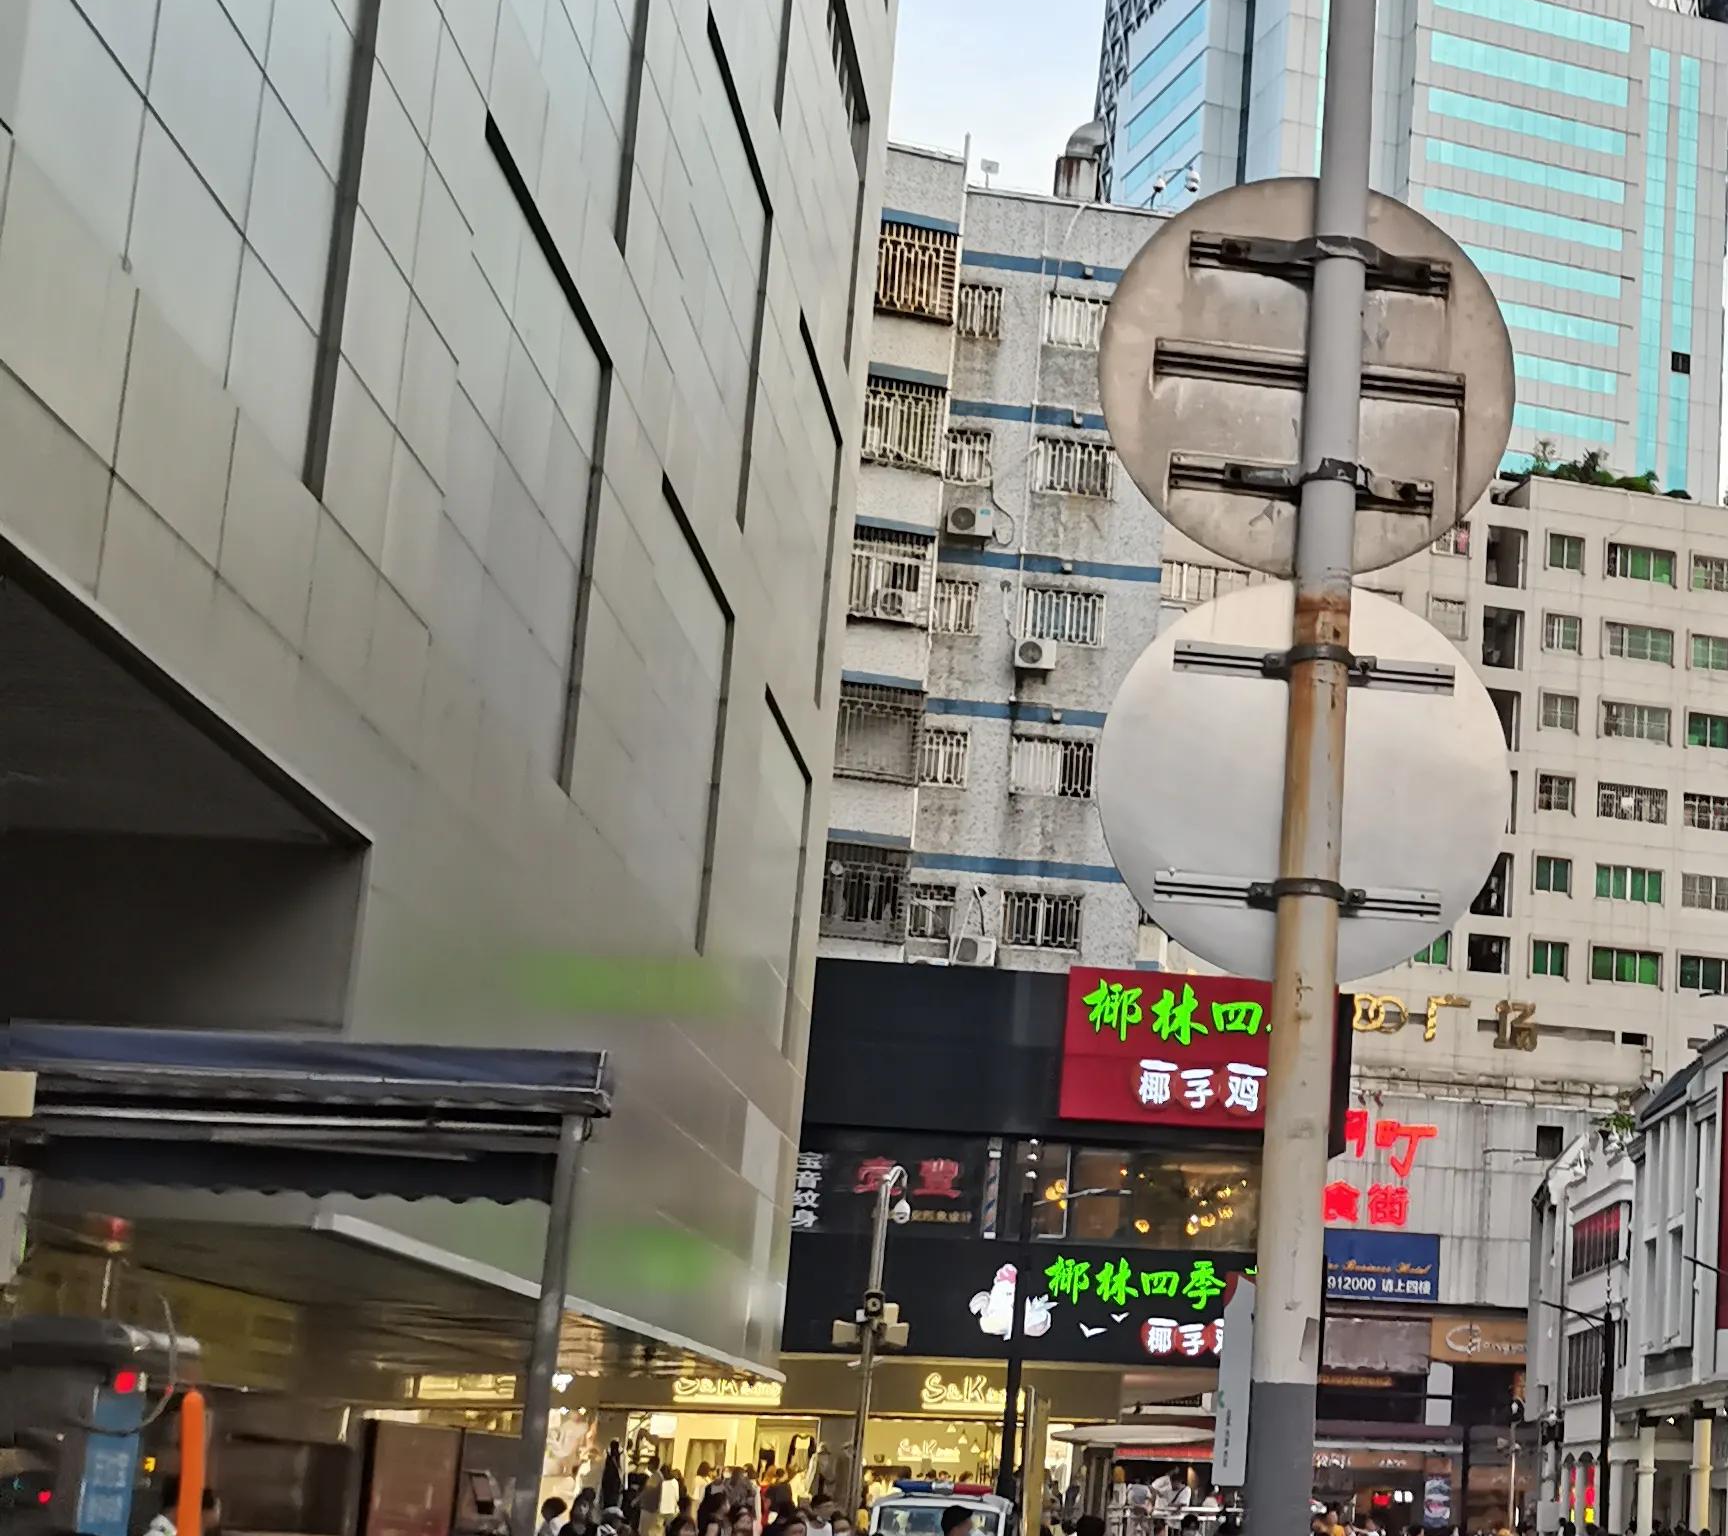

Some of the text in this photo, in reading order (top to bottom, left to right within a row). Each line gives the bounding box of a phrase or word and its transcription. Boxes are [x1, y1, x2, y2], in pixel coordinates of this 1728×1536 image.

[1082, 978, 1273, 1046] 椰林四
[1138, 1059, 1268, 1112] 椰子鸡
[1044, 1255, 1227, 1310] 椰林四季
